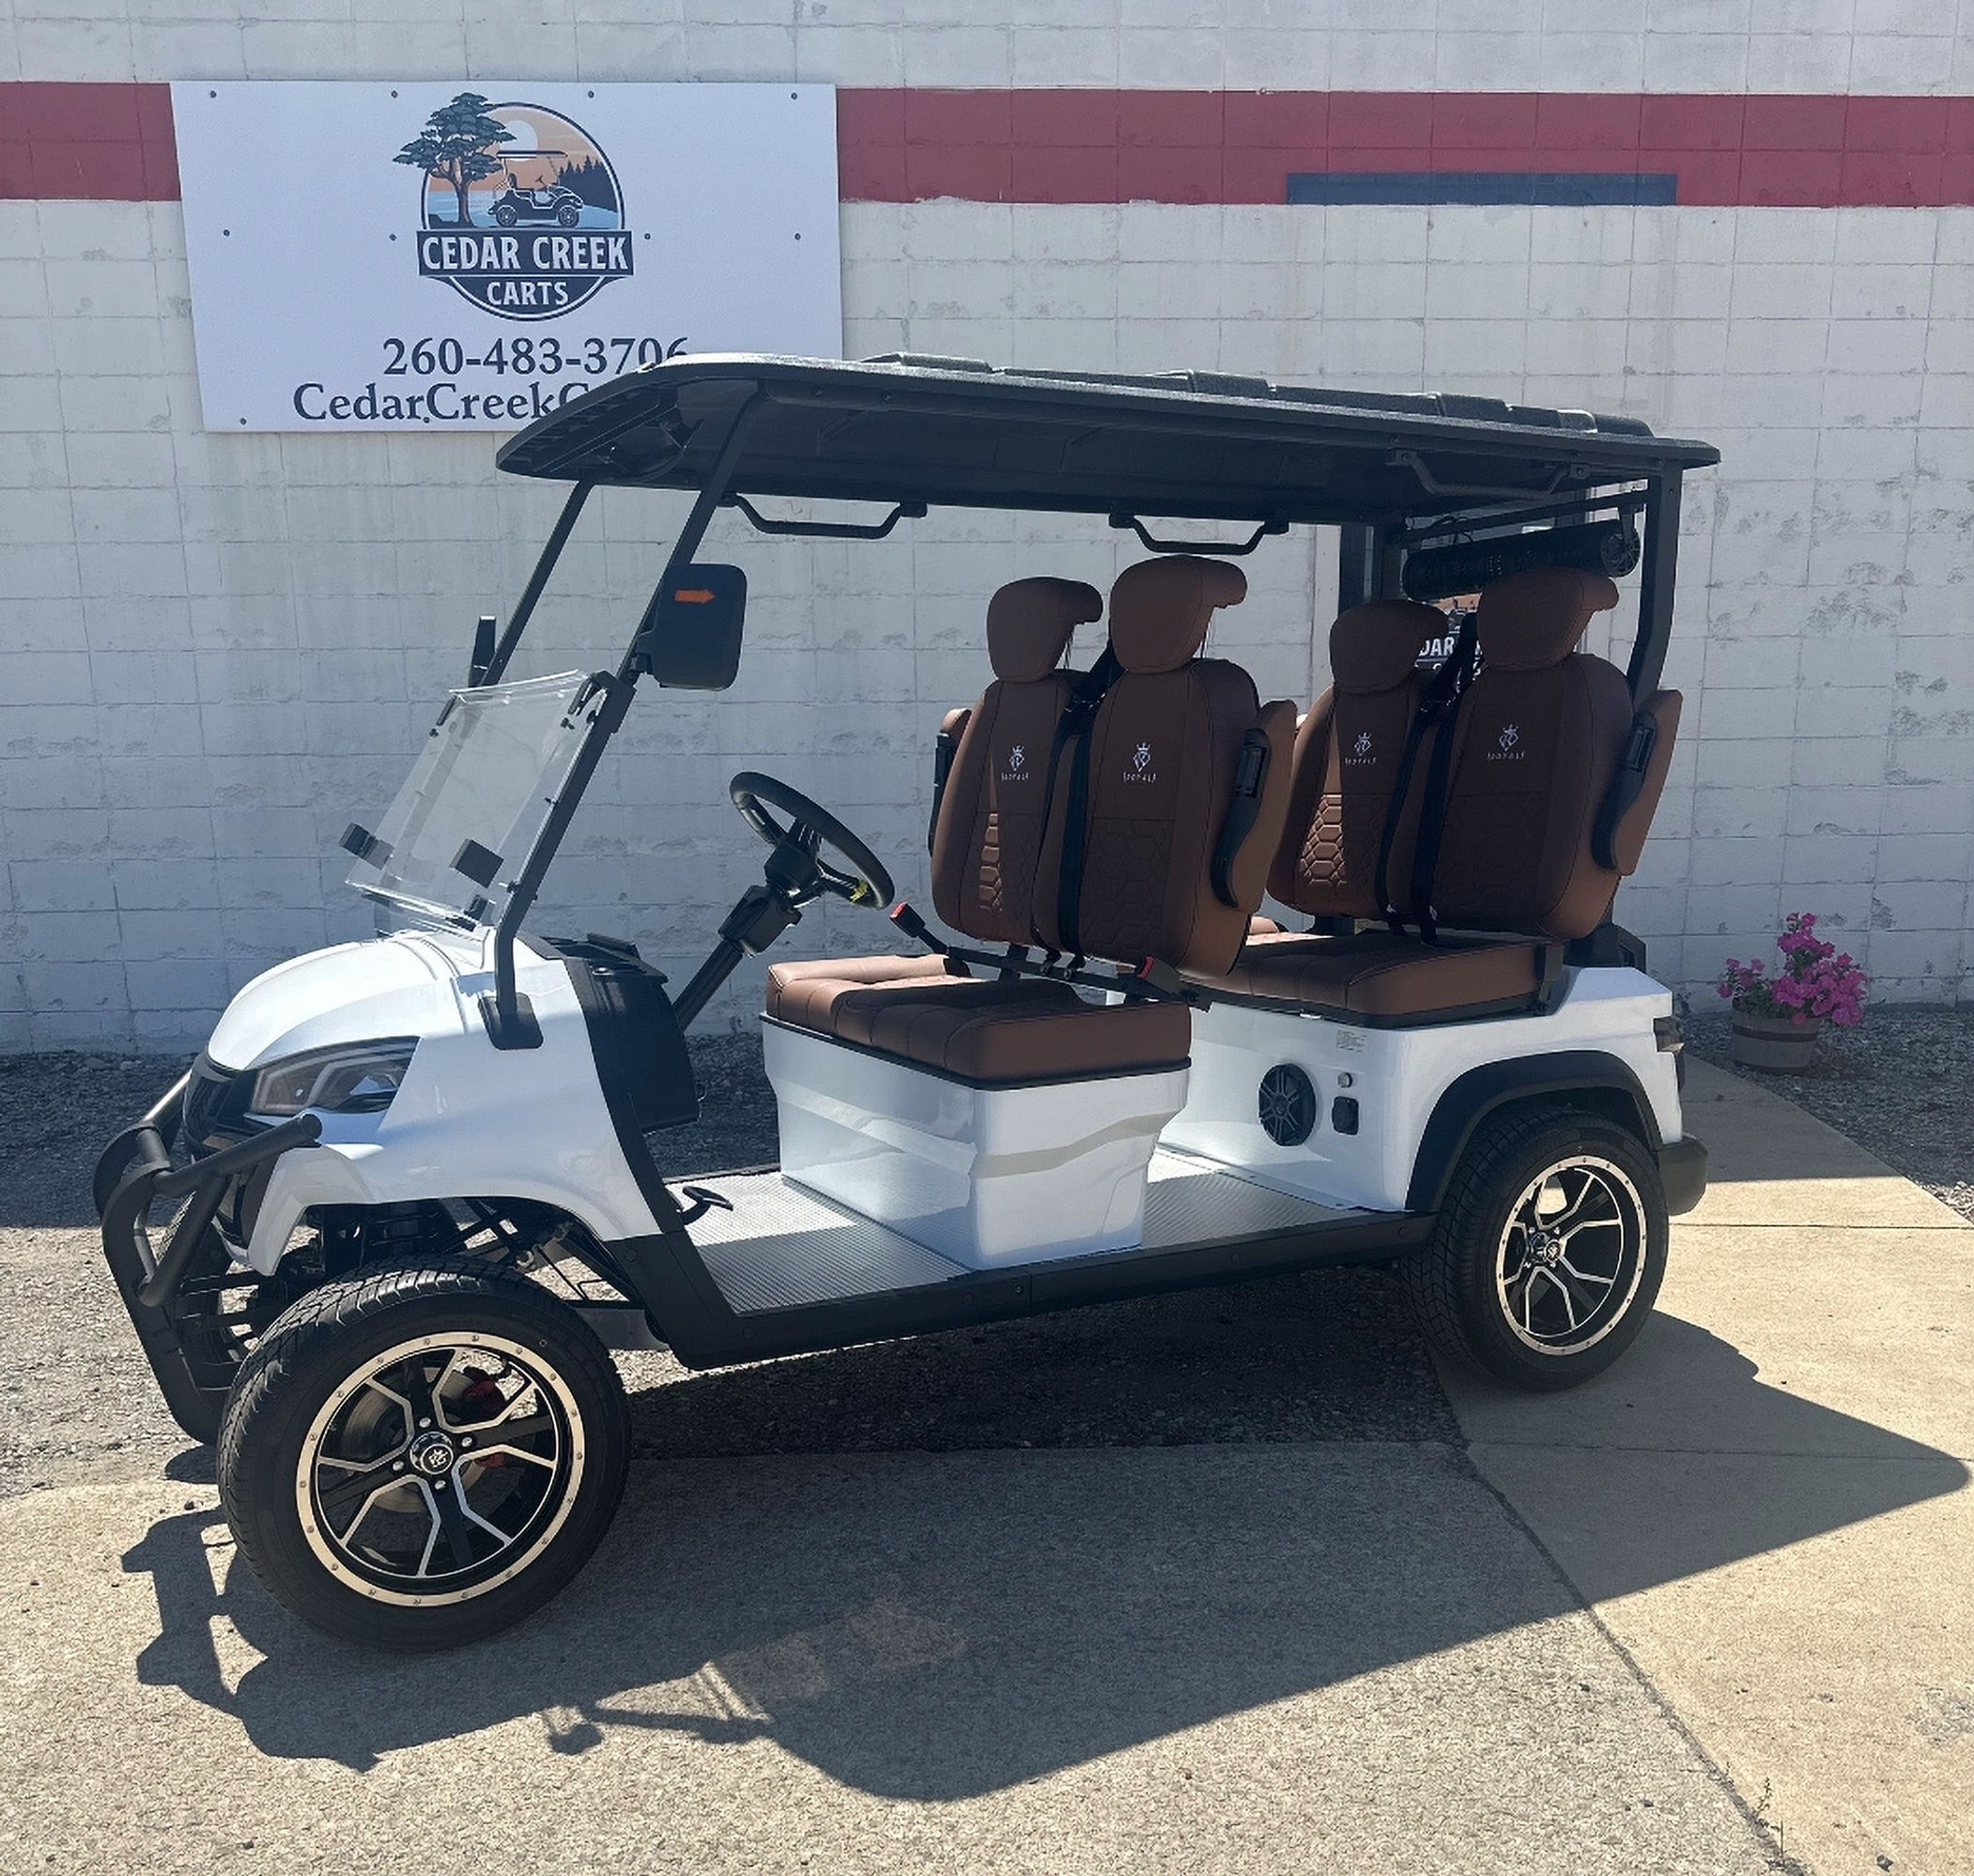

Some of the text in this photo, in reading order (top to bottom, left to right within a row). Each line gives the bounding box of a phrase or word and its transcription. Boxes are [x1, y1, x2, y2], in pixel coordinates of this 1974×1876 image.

[424, 237, 628, 270] CEDAR CREEK
[486, 282, 569, 306] CARTS
